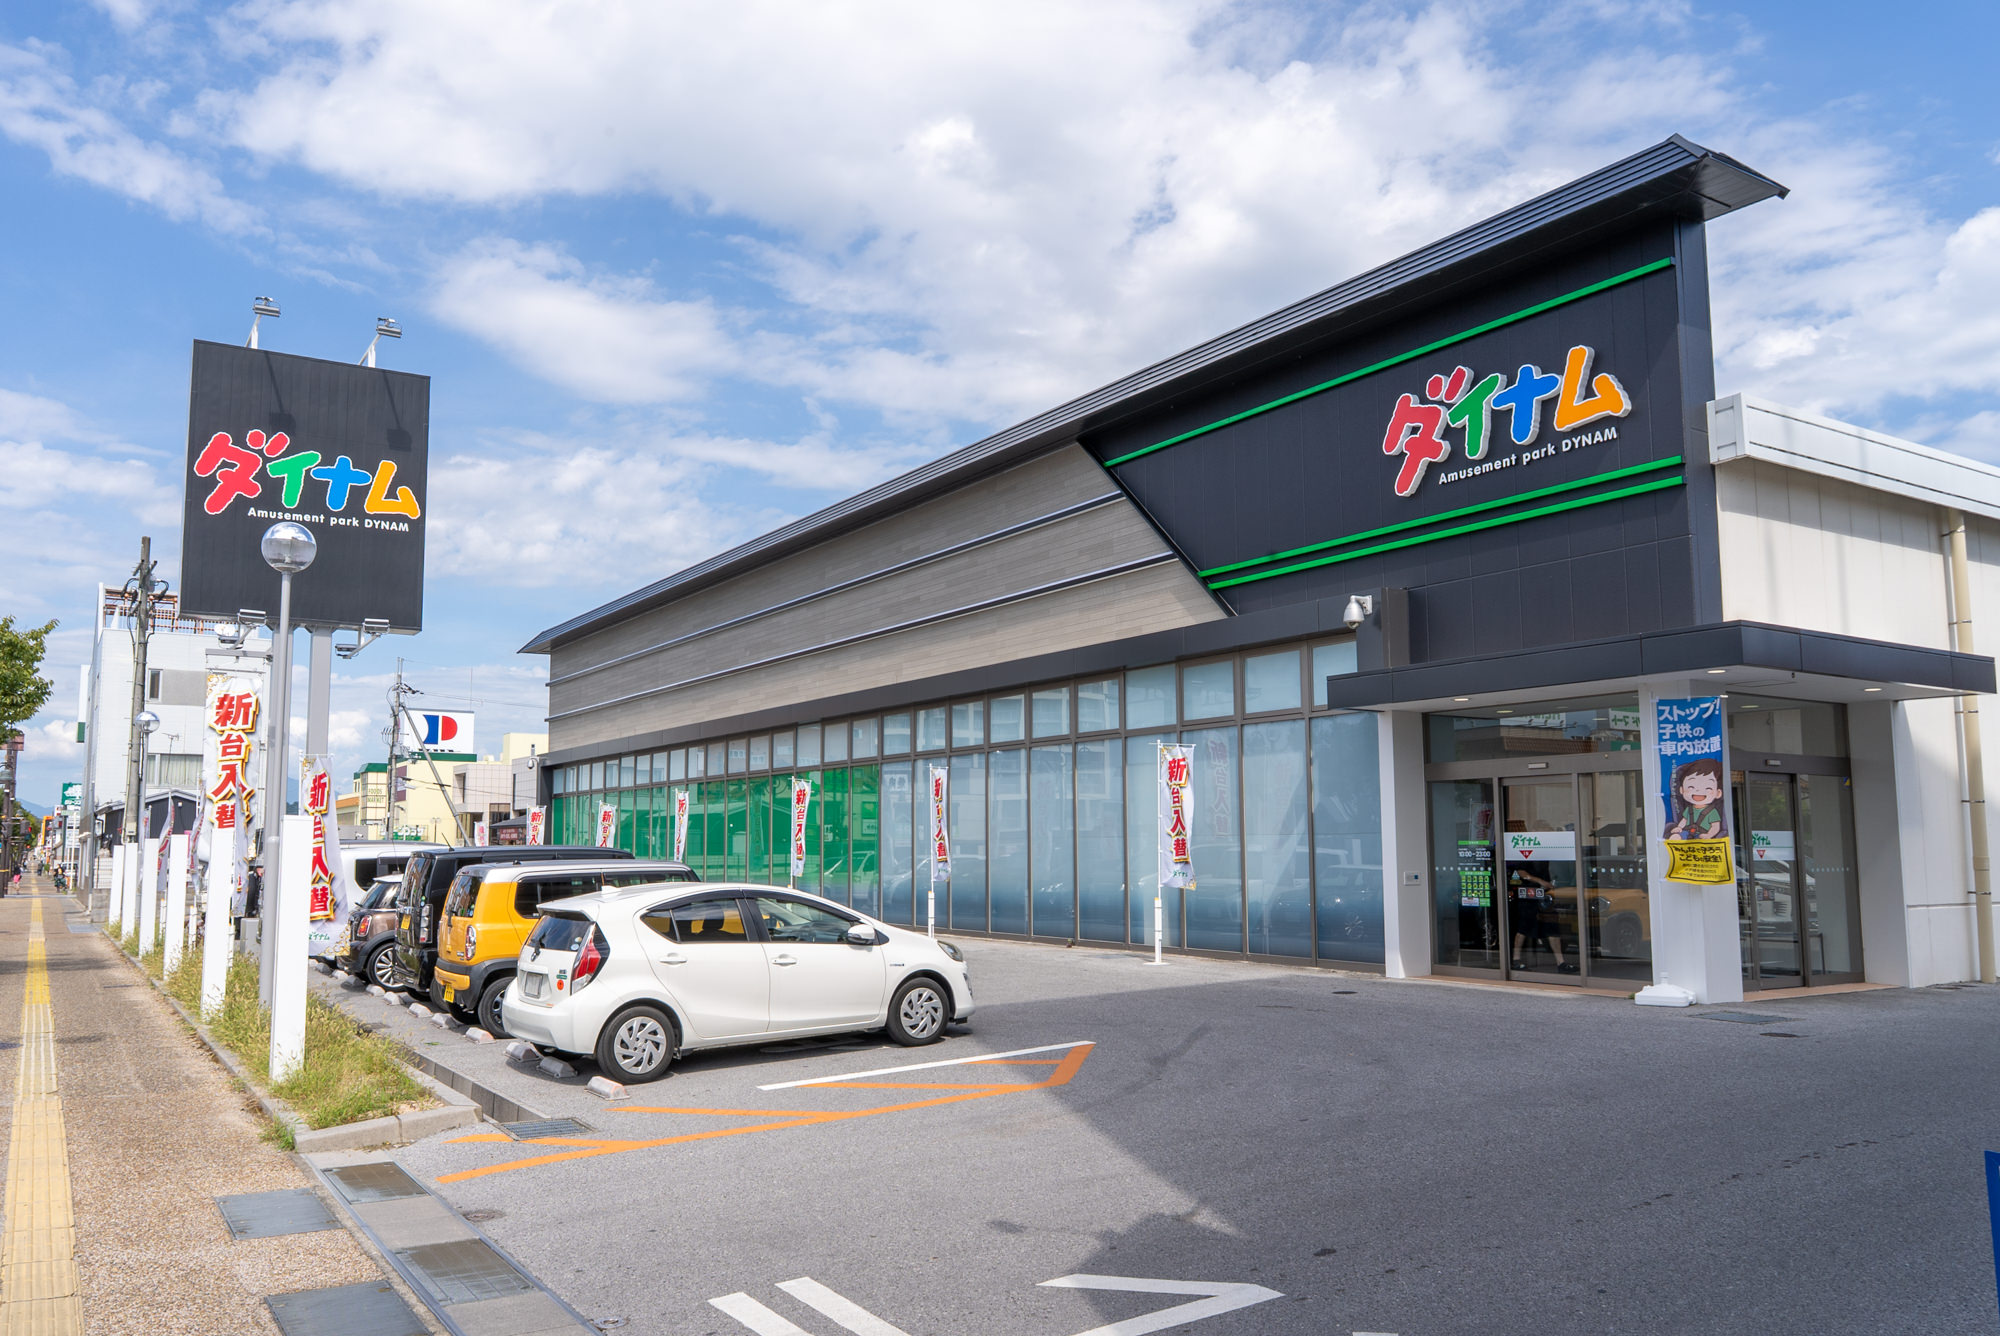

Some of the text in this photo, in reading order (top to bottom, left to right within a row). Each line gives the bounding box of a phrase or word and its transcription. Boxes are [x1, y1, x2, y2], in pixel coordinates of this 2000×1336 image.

[1382, 344, 1632, 497] ダイナム
[194, 429, 421, 520] ダイナム
[1438, 427, 1618, 485] Amusement park DYNAM
[247, 507, 410, 532] Amusement park DYNAM
[1659, 723, 1705, 739] 子供の
[1660, 735, 1721, 756] 車内放置
[1167, 757, 1187, 857] 新台入替
[1511, 834, 1541, 848] ダイナム
